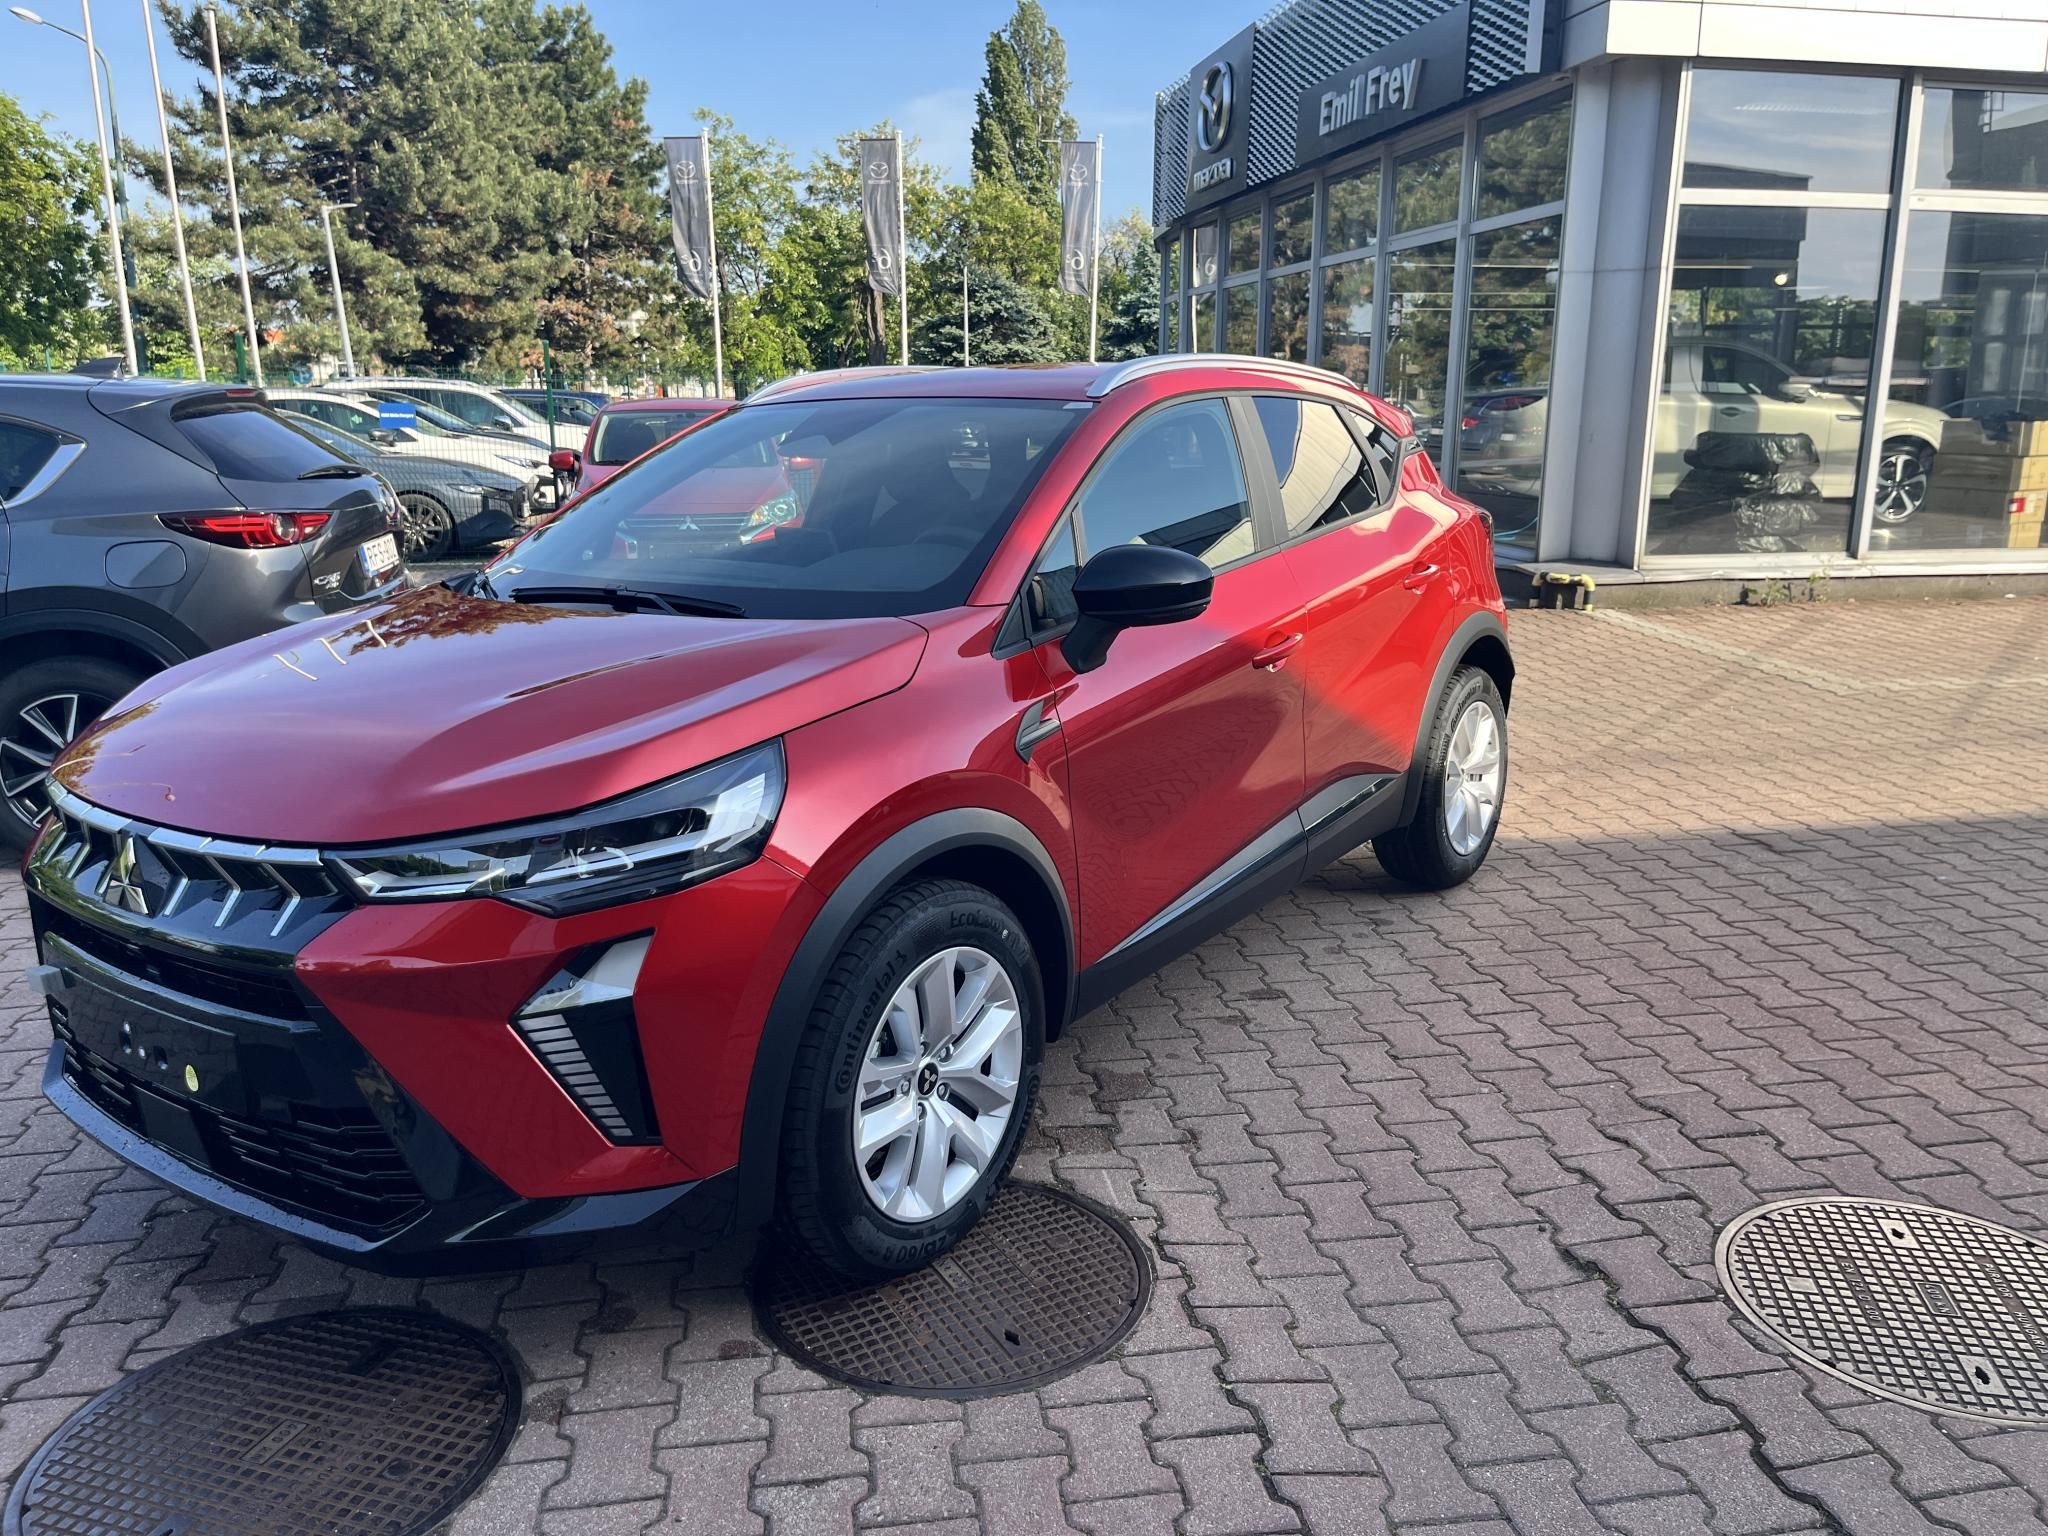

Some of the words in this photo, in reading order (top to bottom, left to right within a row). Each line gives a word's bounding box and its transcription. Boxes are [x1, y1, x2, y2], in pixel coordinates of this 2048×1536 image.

[1319, 74, 1364, 136] Emil
[1365, 58, 1420, 115] Frey
[834, 961, 897, 1096] Continental
[1981, 1263, 2014, 1298] PURATOR
[2014, 1311, 2048, 1354] HUNGARIA
